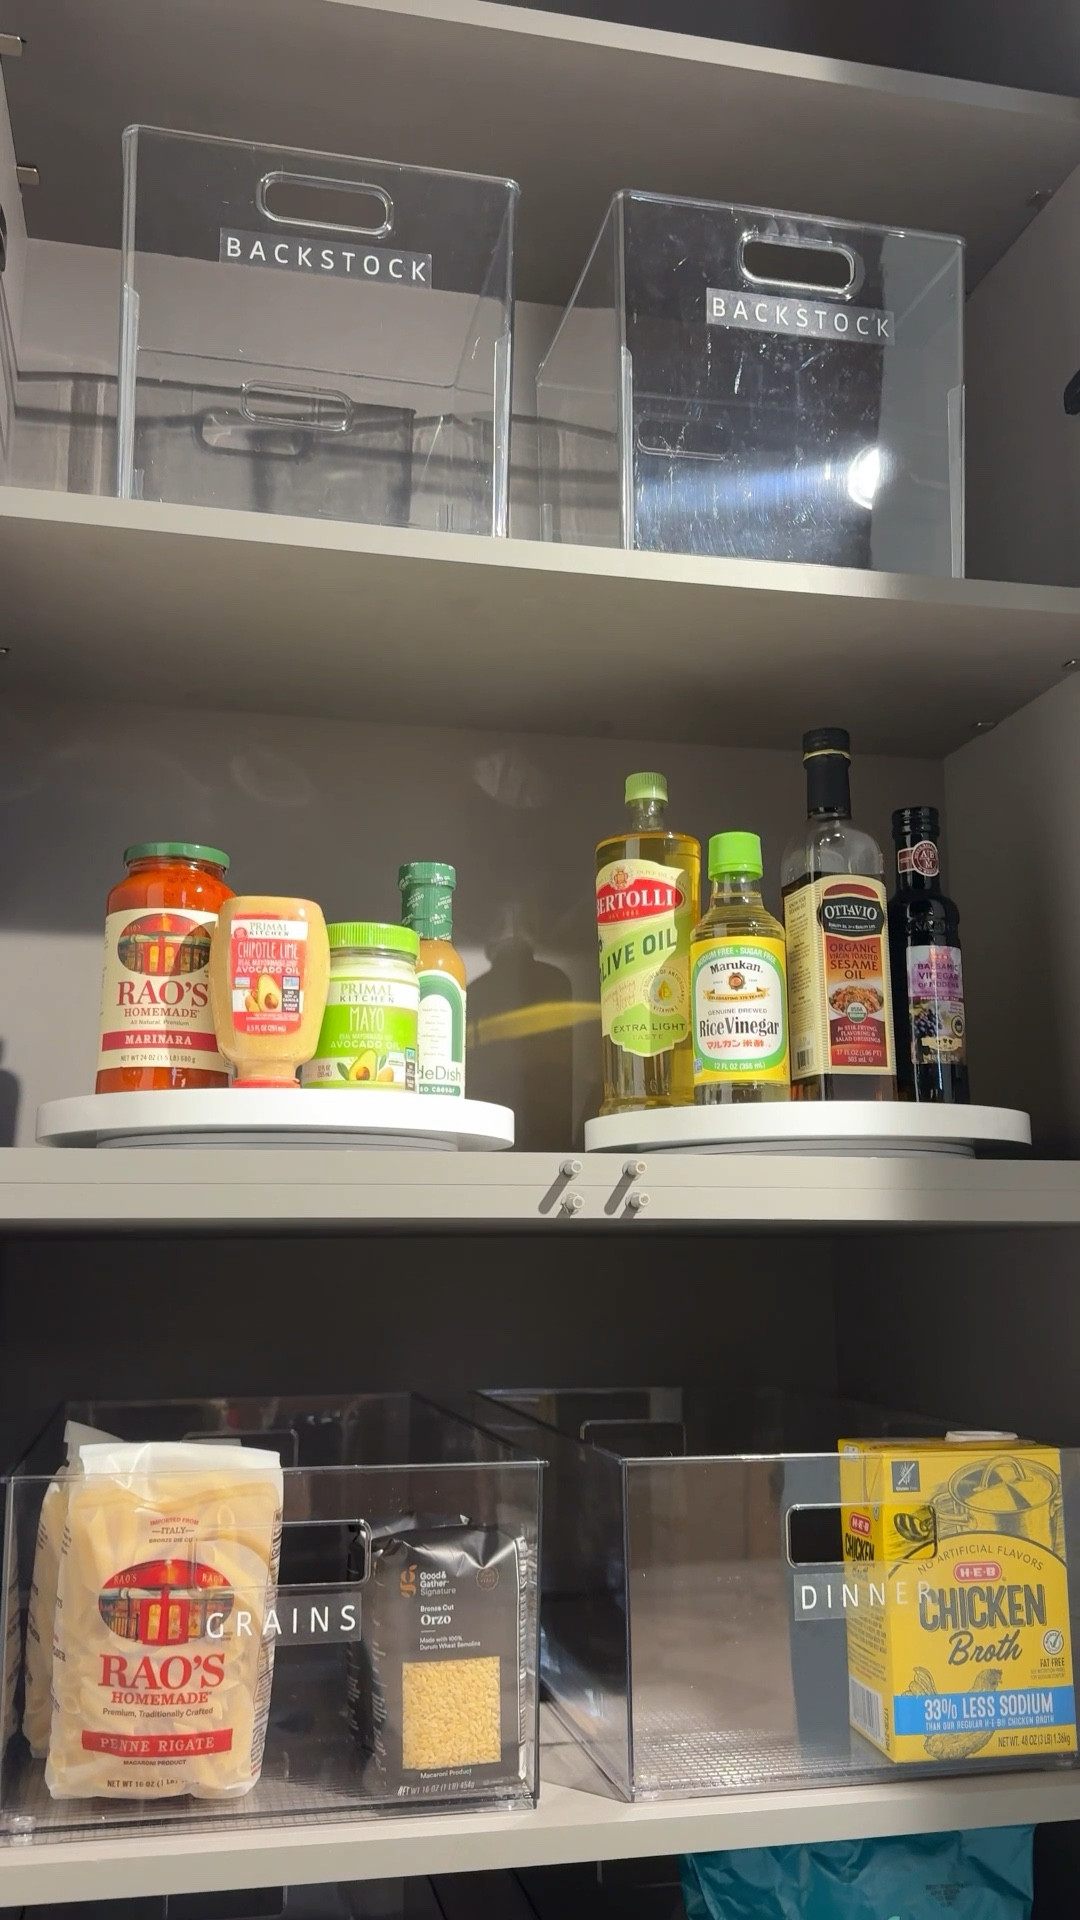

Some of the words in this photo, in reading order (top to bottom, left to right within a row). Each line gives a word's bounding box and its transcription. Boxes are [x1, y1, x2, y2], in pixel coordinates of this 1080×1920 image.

[226, 237, 427, 281] BACKSTOCK
[712, 297, 890, 338] BACKSTOCK
[824, 904, 878, 920] OTTAVIO
[250, 922, 287, 931] PRIMAL
[238, 941, 277, 959] CHIPOTLE
[280, 942, 298, 960] LIME
[830, 944, 878, 954] ORGANIC
[600, 942, 635, 986] LIVE
[642, 928, 676, 955] OIL
[697, 950, 717, 968] SODIUM
[718, 947, 734, 956] FREE
[740, 946, 763, 956] SUGAR
[764, 950, 776, 964] FREE
[236, 966, 282, 974] AVOCADO
[286, 966, 299, 974] OIL
[710, 960, 761, 975] Marukan
[830, 960, 878, 972] SESAME
[918, 964, 958, 972] BASAMIC
[844, 970, 866, 980] OIL
[116, 980, 208, 1008] RAO'S
[340, 982, 392, 996] PRIMAL
[124, 1008, 198, 1018] HOMEMADE
[350, 1006, 384, 1032] MAYO
[708, 1008, 736, 1016] GENUINE
[614, 1024, 647, 1034] EXTRA
[652, 1022, 686, 1031] LIGHT
[700, 1019, 725, 1038] Rice
[725, 1016, 780, 1037] Vinegar
[125, 1034, 192, 1046] MARINARA
[330, 1040, 382, 1048] AVOCADO
[386, 1041, 400, 1050] OIL
[130, 1054, 140, 1062] WT
[170, 1054, 180, 1062] LB)
[714, 1062, 720, 1070] 12
[722, 1062, 728, 1070] FL
[730, 1062, 738, 1070] OZ
[432, 1085, 455, 1094] caesar
[150, 1517, 180, 1526] IMPORTED
[182, 1517, 200, 1526] FROM
[845, 1533, 874, 1561] CHICKEN
[918, 1560, 934, 1575] NO
[938, 1544, 993, 1563] ARTIFICIAL
[998, 1546, 1044, 1571] FLAVORS
[114, 1574, 137, 1584] RAO'S
[420, 1580, 446, 1588] Gather
[420, 1587, 456, 1596] Signature
[801, 1580, 934, 1610] DINNER
[919, 1584, 1046, 1632] CHICKEN
[206, 1605, 356, 1639] GRAINS
[420, 1614, 452, 1626] Orzo
[948, 1629, 1022, 1666] Broth
[1040, 1659, 1050, 1668] FAT
[1051, 1658, 1064, 1667] FREE
[98, 1653, 225, 1690] RAO'S
[111, 1691, 208, 1705] HOMEMADE
[102, 1708, 137, 1718] Premium,
[139, 1710, 184, 1718] Traditionally
[186, 1707, 214, 1716] Crafted
[924, 1699, 958, 1721] 33%
[962, 1697, 996, 1719] LESS
[1000, 1692, 1054, 1716] SODIUM
[926, 1722, 941, 1731] THAN
[942, 1721, 954, 1730] OUR
[957, 1720, 982, 1730] REGULAR
[1008, 1718, 1034, 1726] CHICKEN
[1036, 1716, 1054, 1724] BROTH
[100, 1737, 150, 1752] PENNE
[158, 1736, 214, 1752] RIGATE
[998, 1737, 1010, 1747] NET
[1010, 1736, 1020, 1746] WT.
[1021, 1736, 1028, 1746] 48
[1029, 1735, 1038, 1746] OZ
[1038, 1734, 1044, 1746] (3
[1044, 1734, 1053, 1746] LB)
[1054, 1733, 1070, 1746] 1.36kg
[420, 1771, 448, 1779] Macaroni
[449, 1768, 472, 1776] Product
[107, 1780, 120, 1788] NET
[122, 1780, 132, 1788] WT
[136, 1780, 143, 1788] 16
[146, 1780, 154, 1788] OZ
[398, 1786, 410, 1796] NET
[410, 1786, 420, 1794] WT
[431, 1784, 440, 1792] OZ
[460, 1780, 475, 1790] 454g
